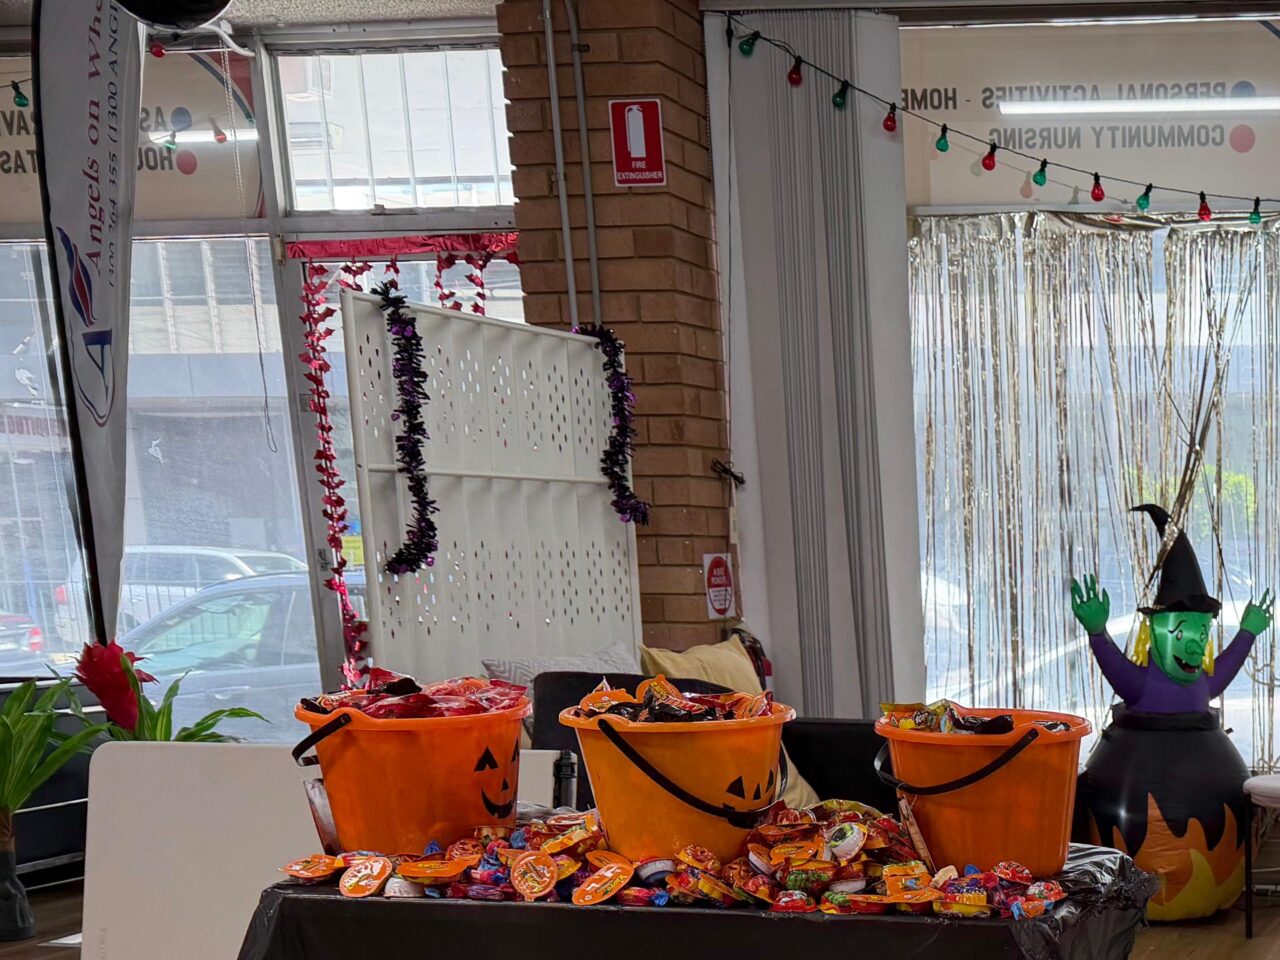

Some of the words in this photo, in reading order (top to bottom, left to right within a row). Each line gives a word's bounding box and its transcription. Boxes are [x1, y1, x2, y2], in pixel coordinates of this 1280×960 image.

[88, 100, 101, 146] on
[107, 151, 119, 192] 355
[617, 171, 663, 180] EXTINGUISHER
[631, 160, 647, 169] FIRE
[82, 156, 104, 274] Angels
